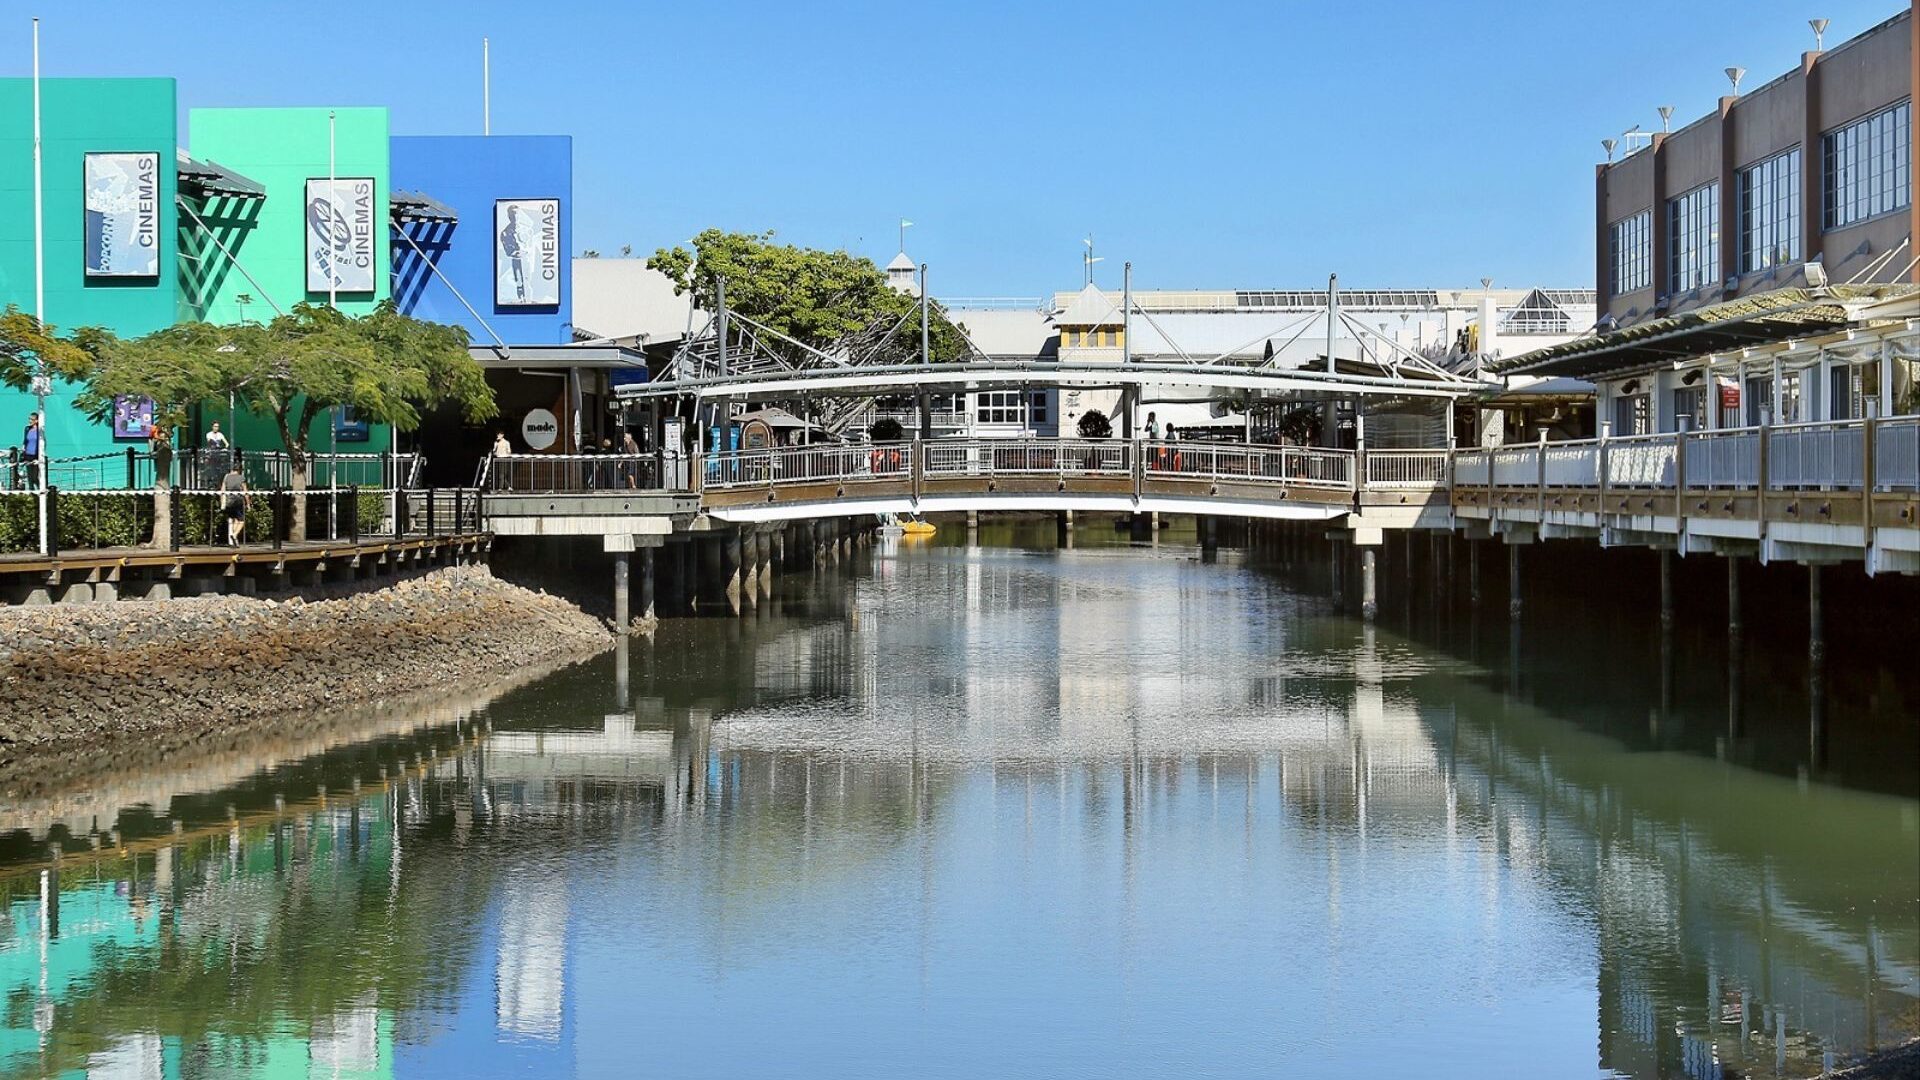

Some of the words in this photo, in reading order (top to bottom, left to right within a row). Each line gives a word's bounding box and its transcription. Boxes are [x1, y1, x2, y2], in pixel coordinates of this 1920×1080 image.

[139, 157, 153, 248] CINEMAS
[355, 183, 369, 268] CINEMAS
[542, 204, 555, 281] CINEMAS
